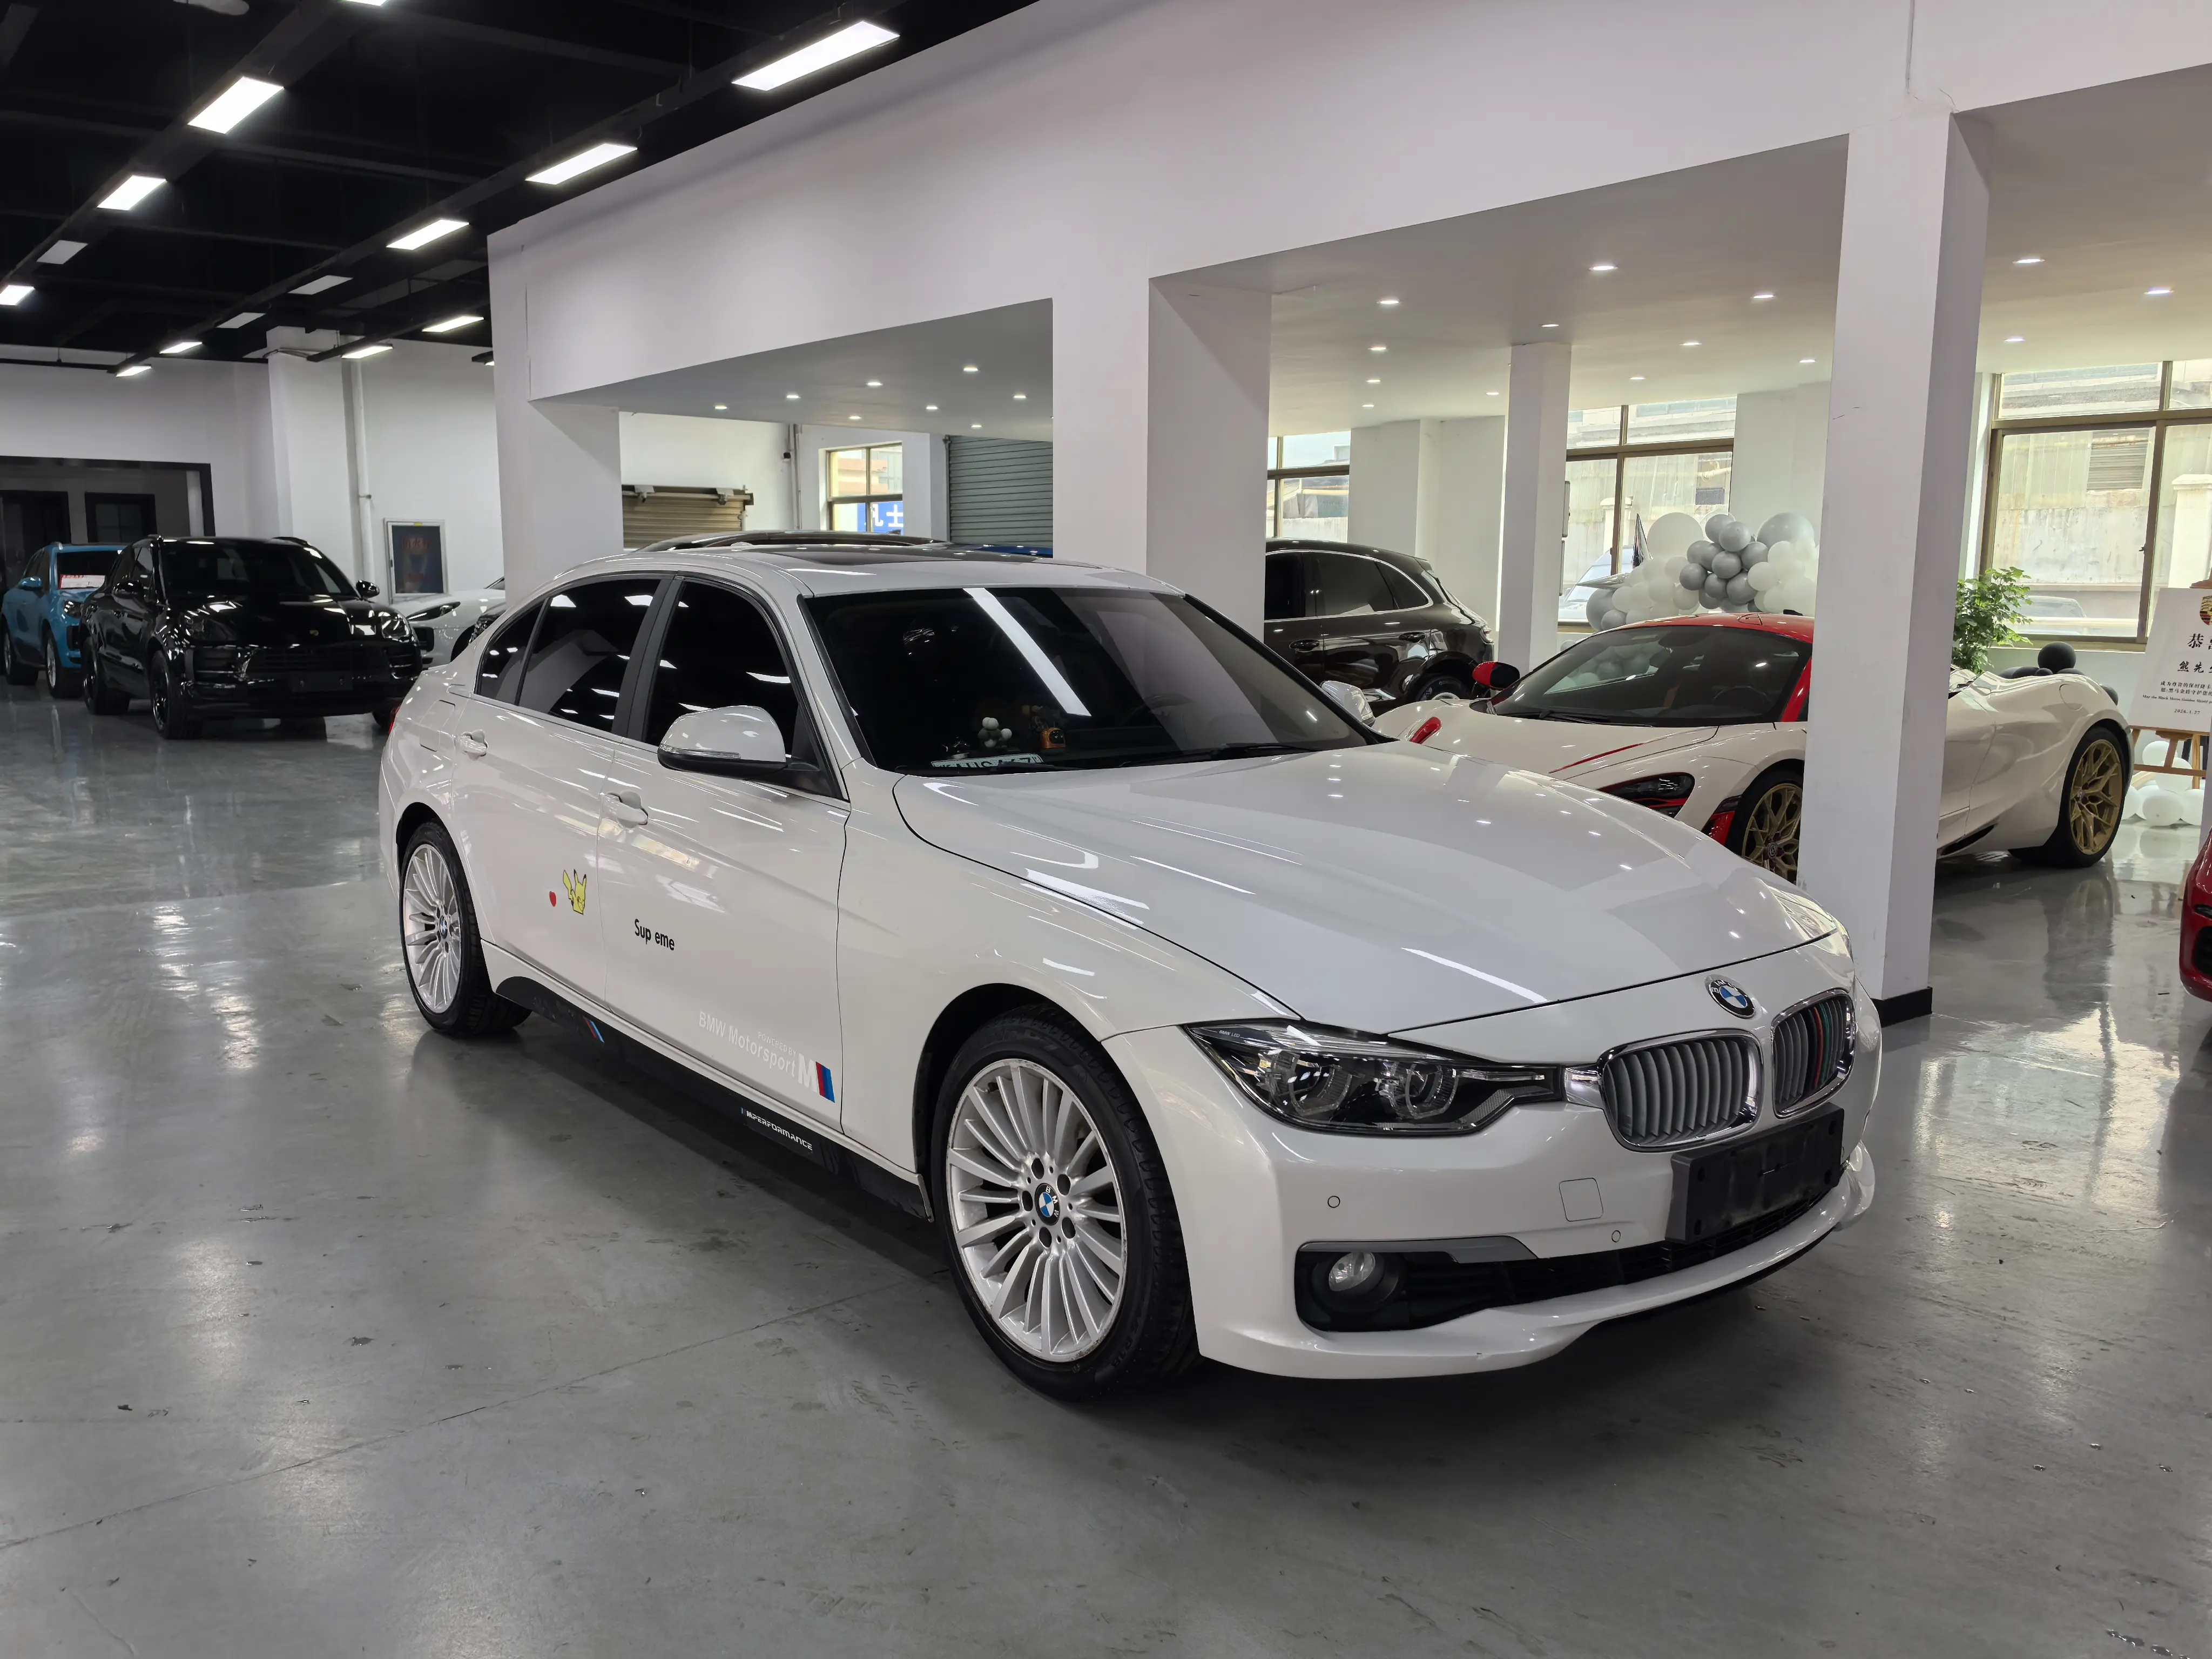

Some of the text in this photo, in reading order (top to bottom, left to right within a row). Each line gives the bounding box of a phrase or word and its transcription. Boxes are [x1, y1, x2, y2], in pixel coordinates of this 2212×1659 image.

[2177, 661, 2212, 673] 熊先
[699, 1010, 796, 1077] BMW Motorsport
[758, 1031, 797, 1056] POWERED BY
